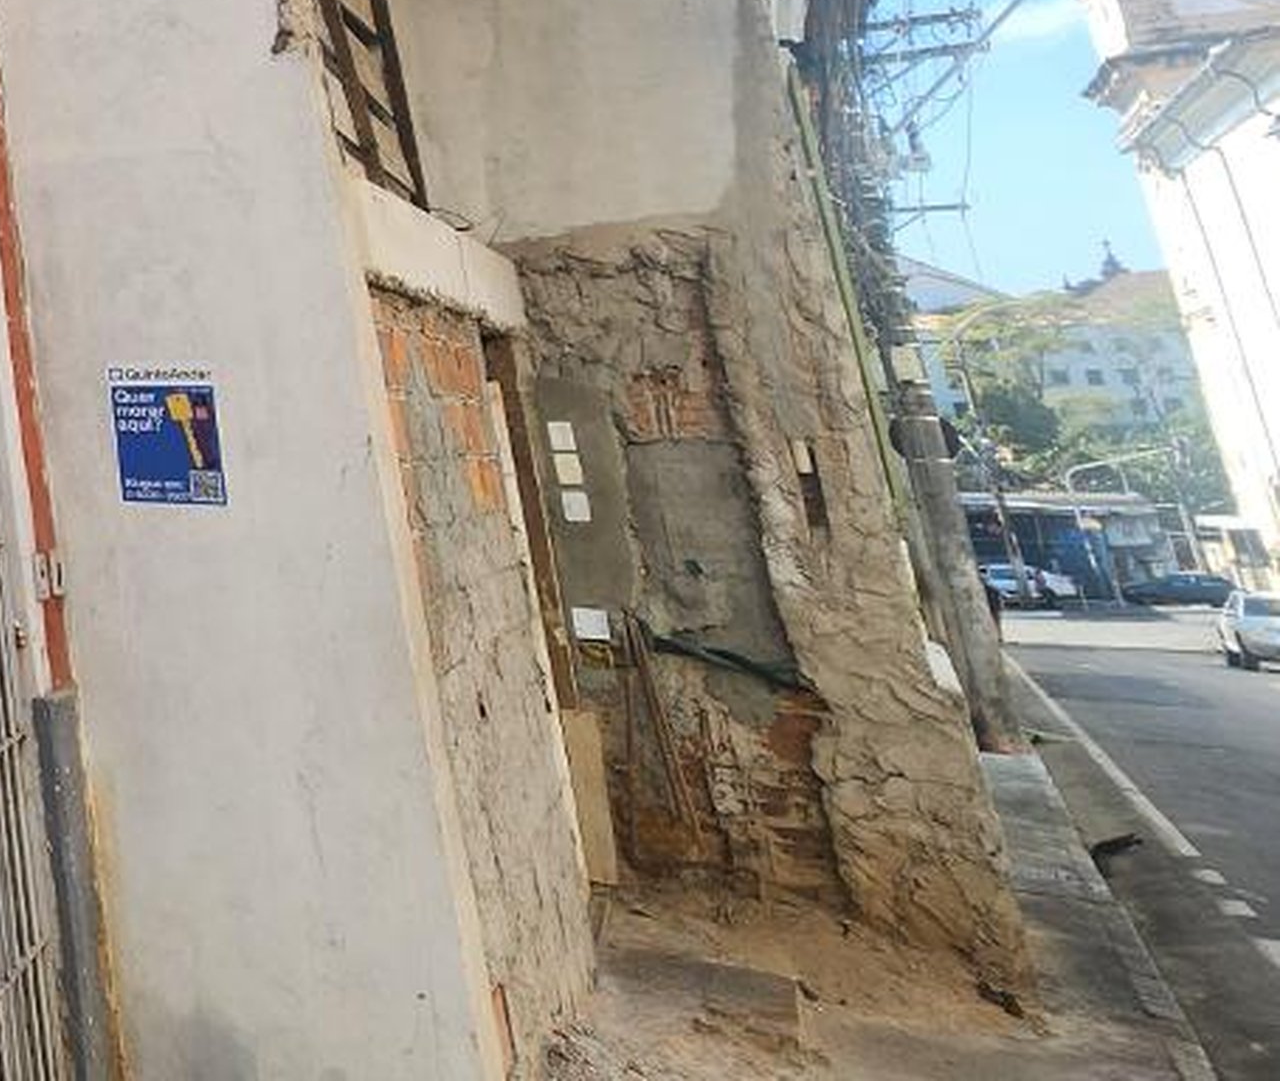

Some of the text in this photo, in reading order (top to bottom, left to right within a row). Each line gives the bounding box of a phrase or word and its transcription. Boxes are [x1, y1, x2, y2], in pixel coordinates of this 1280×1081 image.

[114, 389, 155, 403] Quer
[116, 406, 165, 417] morar
[117, 419, 163, 433] aqui?
